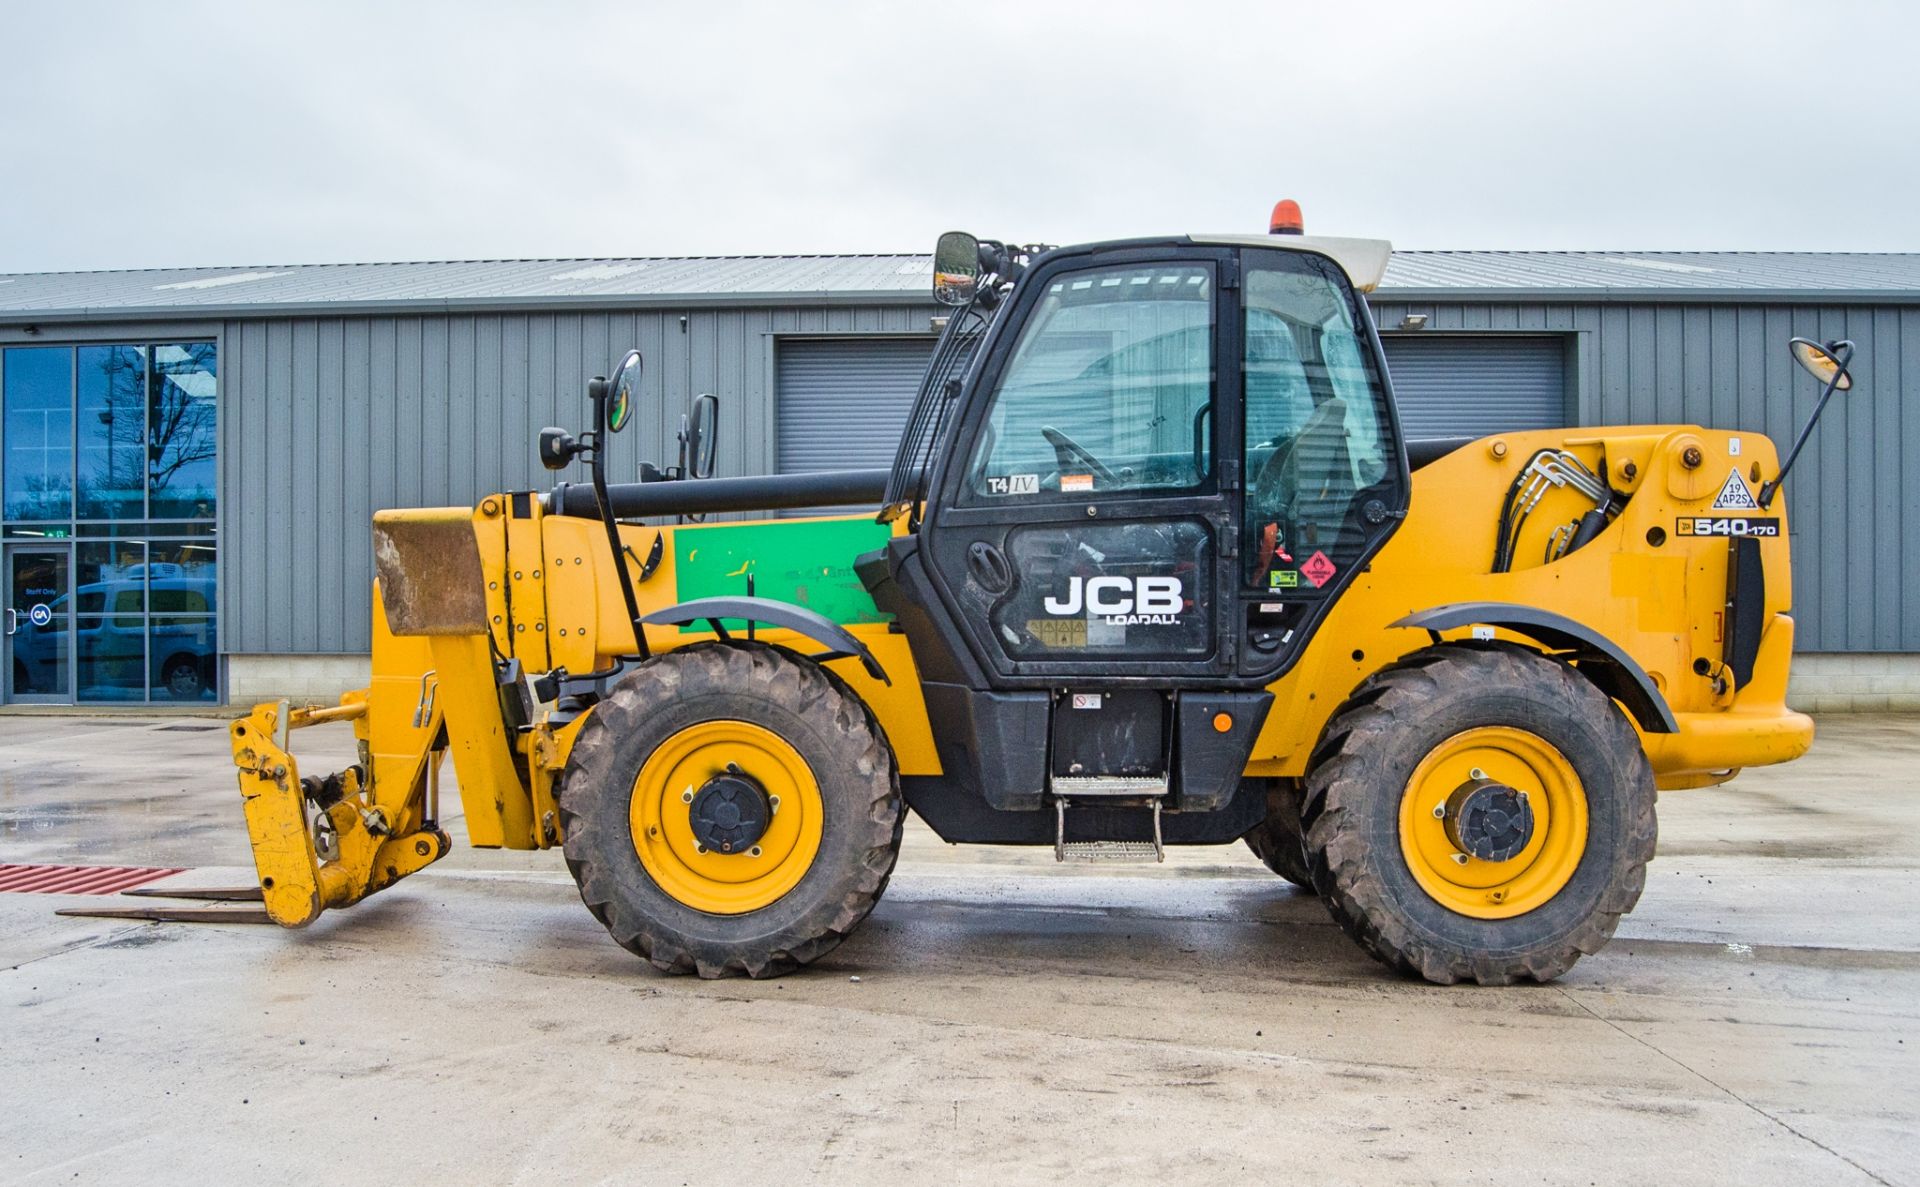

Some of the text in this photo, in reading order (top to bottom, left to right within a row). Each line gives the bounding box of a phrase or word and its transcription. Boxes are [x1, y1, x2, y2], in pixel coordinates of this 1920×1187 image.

[987, 477, 1034, 493] T4 IV
[1729, 483, 1741, 493] 19
[1722, 494, 1748, 504] AP2S
[1044, 576, 1184, 615] JCB
